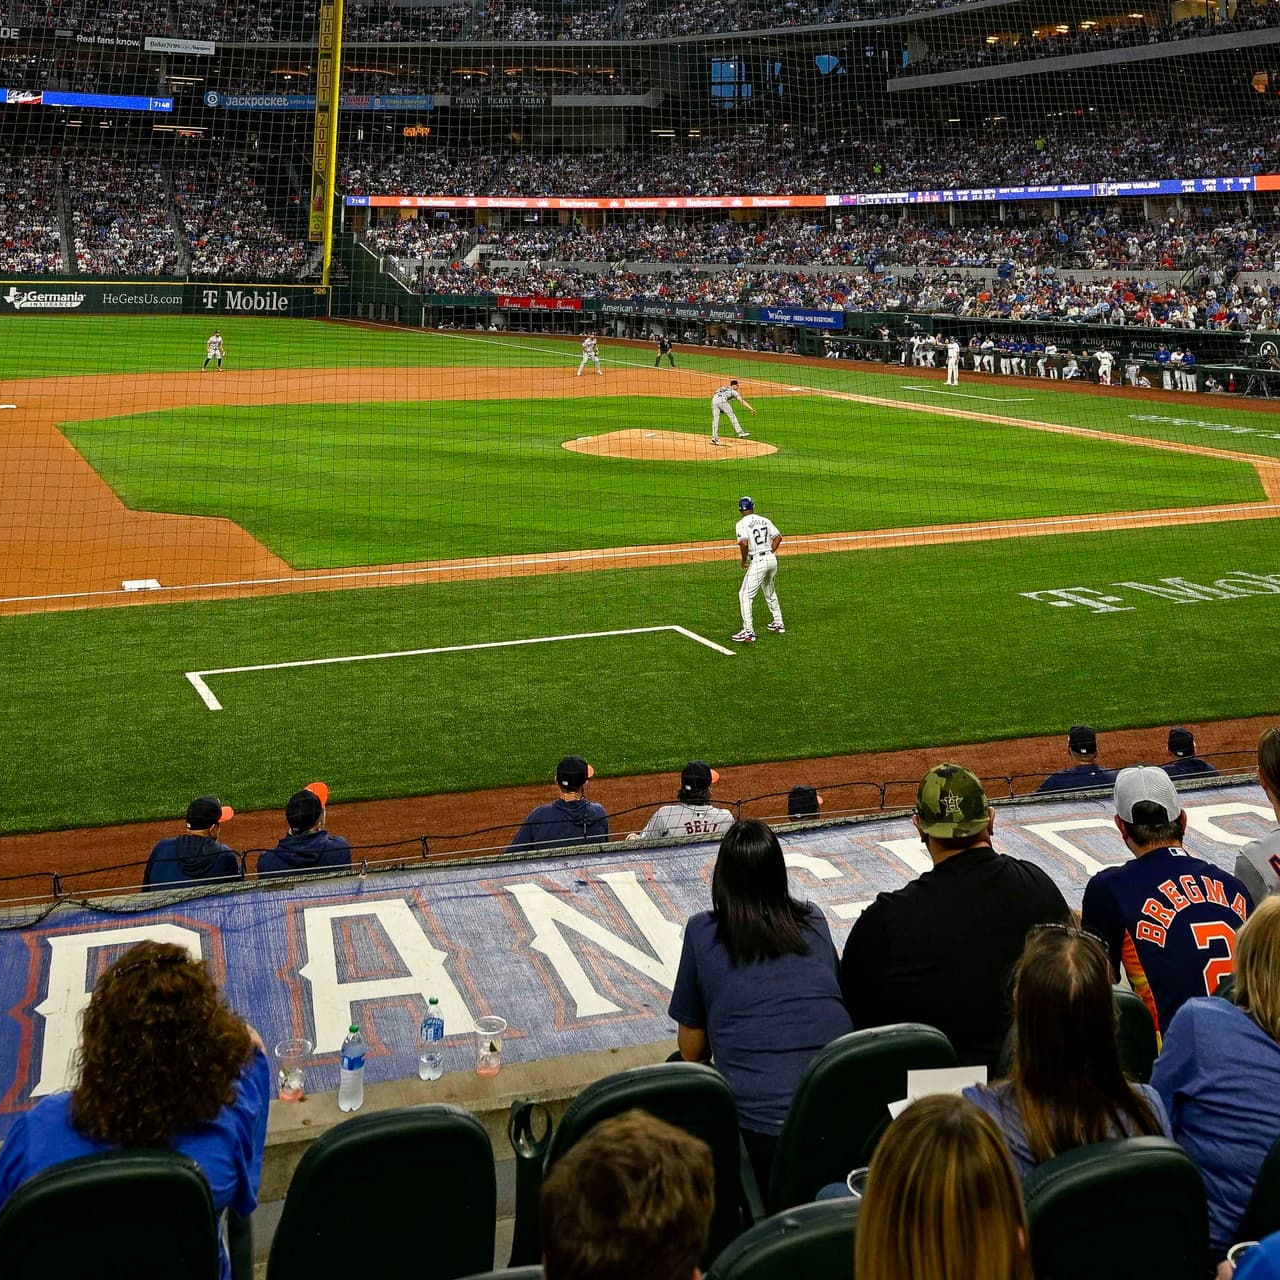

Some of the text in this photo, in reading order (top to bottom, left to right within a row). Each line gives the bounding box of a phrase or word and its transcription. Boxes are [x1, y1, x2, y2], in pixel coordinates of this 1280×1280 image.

[76, 34, 141, 47] Real fans know.
[314, 5, 334, 171] THE HOT ZONE
[225, 96, 288, 108] Jackpocket
[487, 96, 513, 106] PERRY
[520, 96, 546, 106] PERRY
[28, 291, 84, 302] Germania
[312, 287, 327, 296] 326
[102, 293, 183, 305] HeGetsUs.com
[225, 291, 288, 311] Mobile
[602, 304, 634, 313] American
[642, 306, 666, 315] American
[675, 308, 699, 317] American
[709, 310, 735, 319] American
[1086, 337, 1121, 348] CHOCTAW
[753, 527, 768, 545] 27
[1190, 921, 1238, 996] 2
